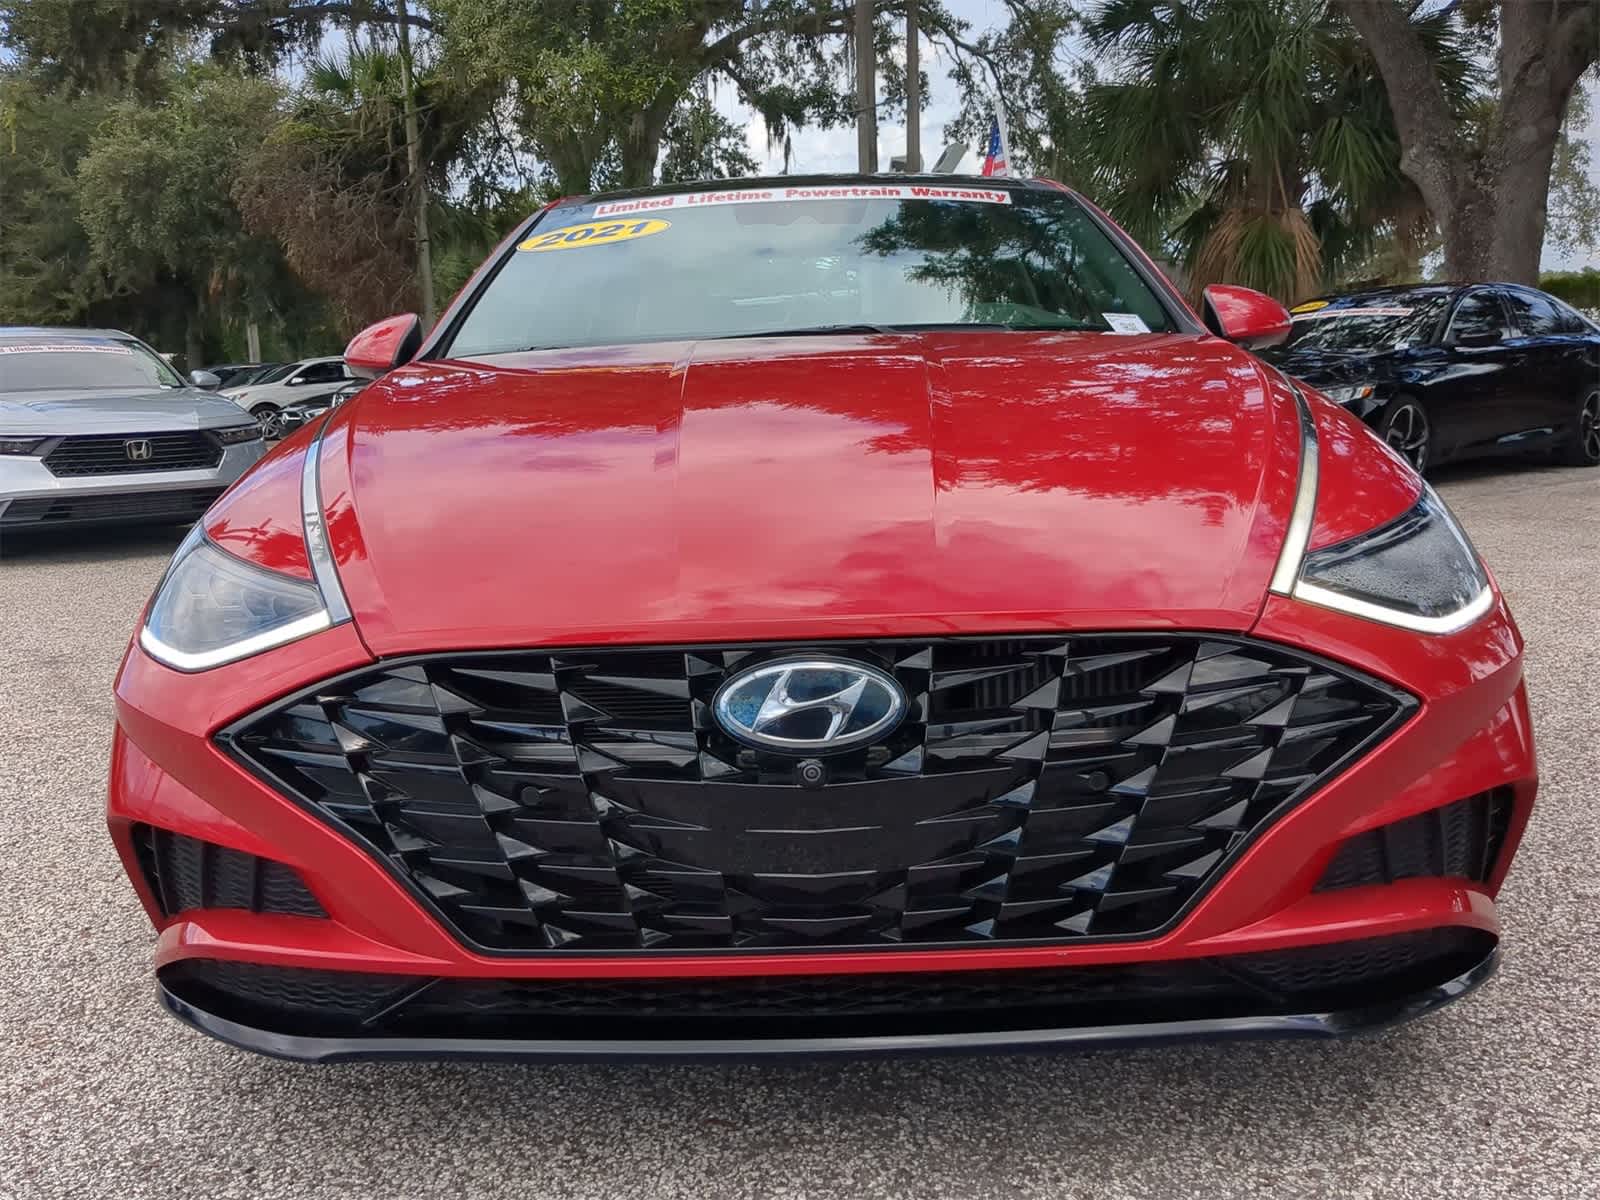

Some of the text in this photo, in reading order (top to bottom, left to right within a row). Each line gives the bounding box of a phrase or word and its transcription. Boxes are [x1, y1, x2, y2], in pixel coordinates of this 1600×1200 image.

[597, 186, 1008, 216] Limited Lifetime Powertrain Warranty
[534, 220, 652, 248] 2021
